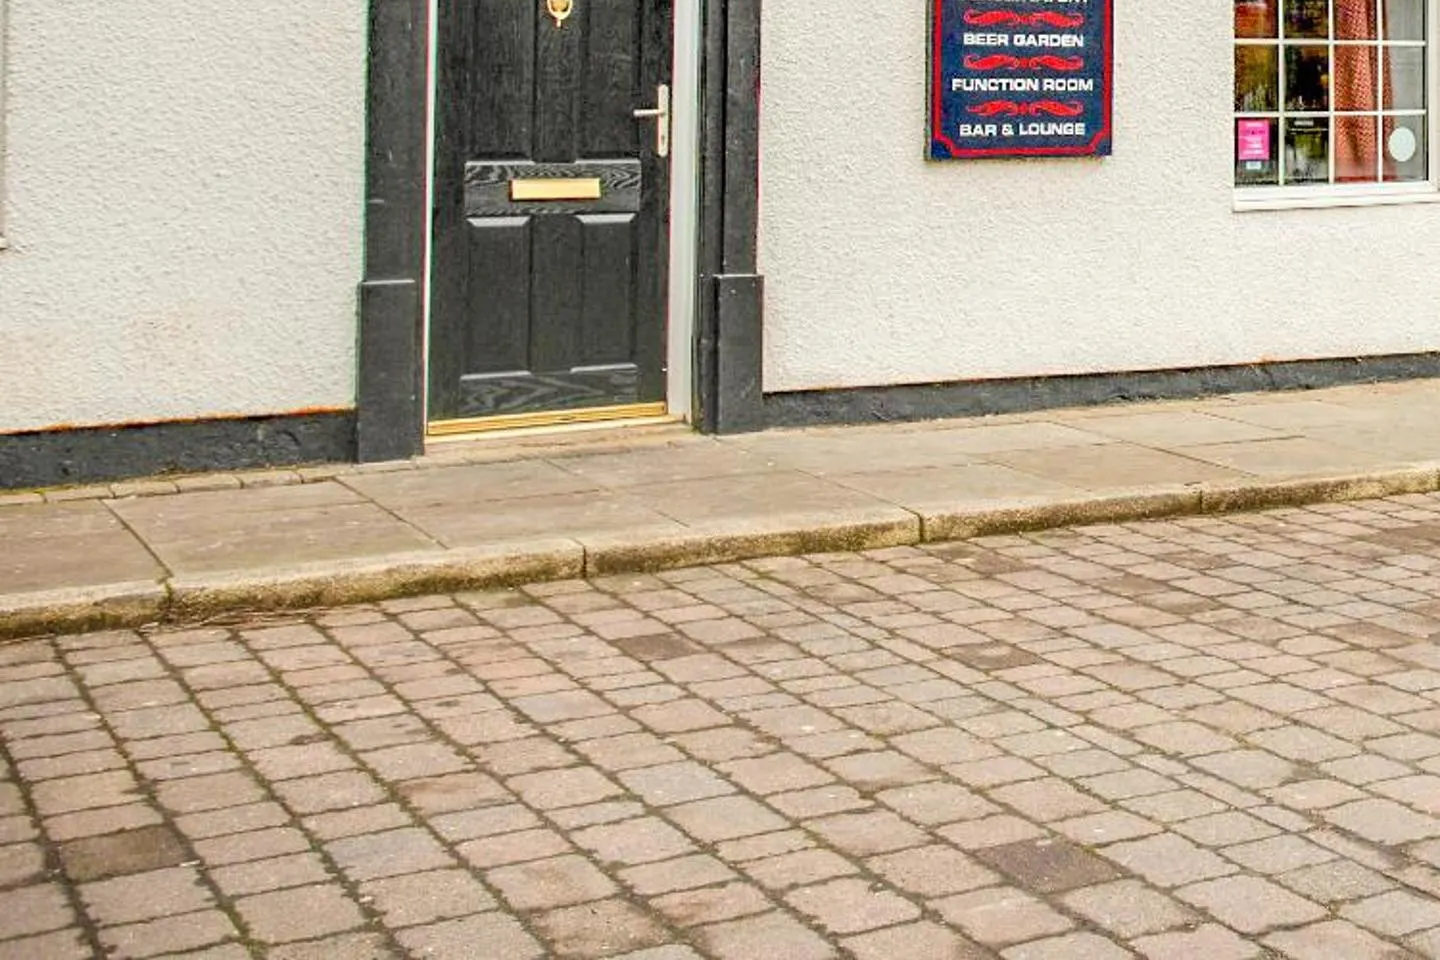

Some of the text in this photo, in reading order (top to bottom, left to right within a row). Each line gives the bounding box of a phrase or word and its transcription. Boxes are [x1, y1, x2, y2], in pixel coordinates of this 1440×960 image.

[963, 33, 1084, 47] BEER GARDEN
[951, 78, 1094, 91] FUNCTION ROOM
[959, 123, 1086, 136] BAR & LOUNGE
